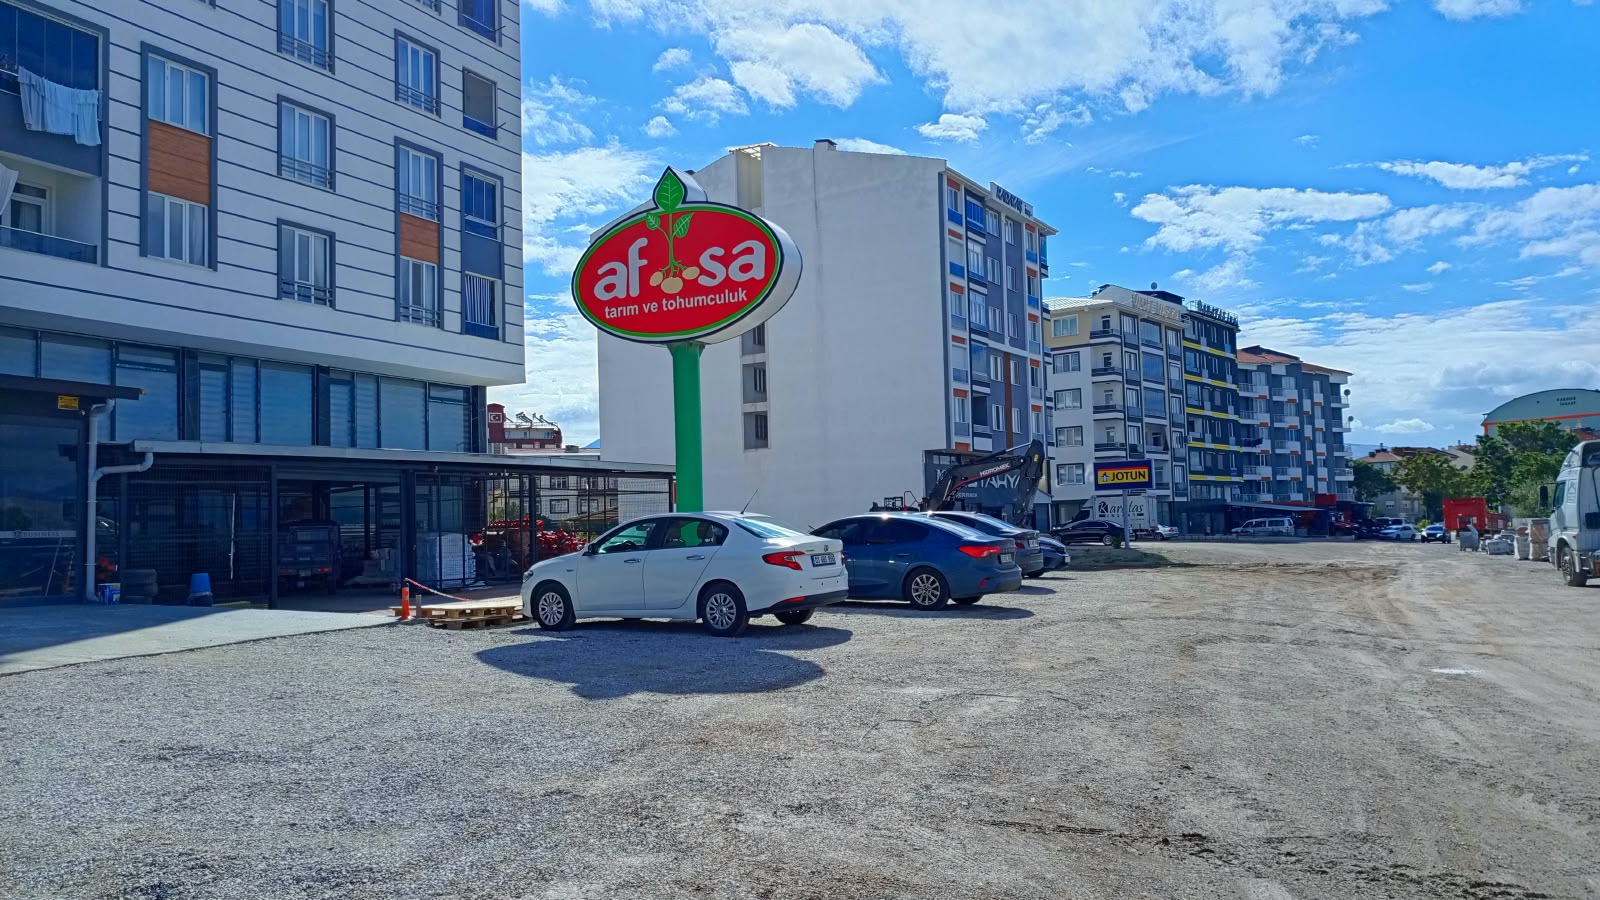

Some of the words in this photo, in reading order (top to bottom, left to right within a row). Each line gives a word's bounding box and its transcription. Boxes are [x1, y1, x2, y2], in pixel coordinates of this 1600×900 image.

[605, 303, 639, 319] tarım
[643, 301, 659, 313] ve
[662, 288, 747, 311] tohumculuk
[1111, 471, 1146, 481] JOTUN
